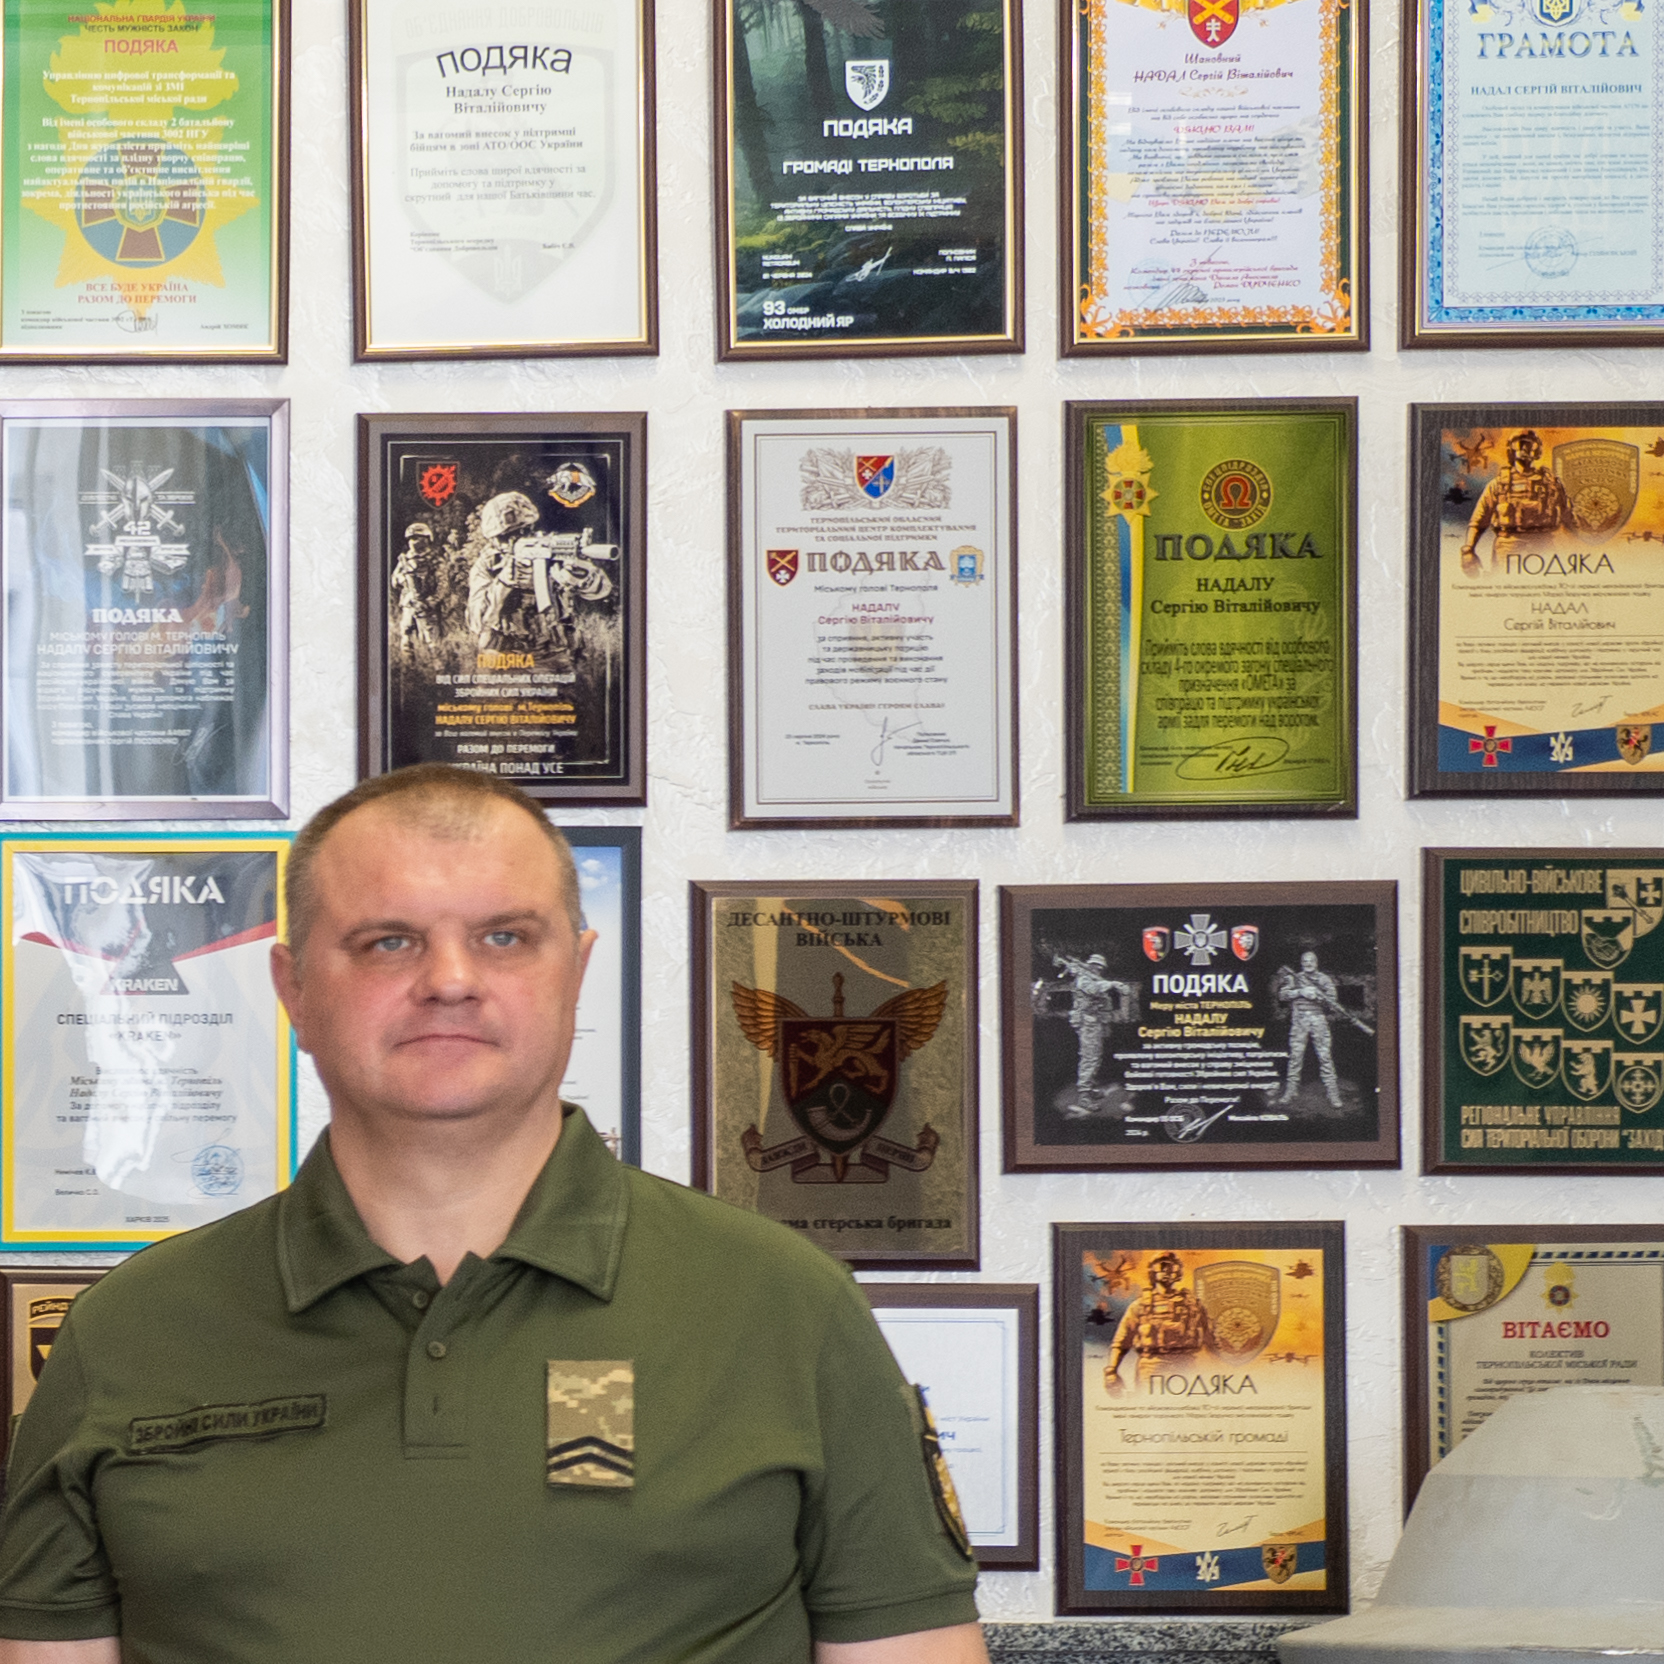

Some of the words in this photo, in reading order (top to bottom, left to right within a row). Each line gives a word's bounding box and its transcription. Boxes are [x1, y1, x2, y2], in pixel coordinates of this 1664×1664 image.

[85, 23, 112, 33] ЧЕСТЬ
[166, 24, 199, 33] ЗАКОН
[104, 38, 178, 57] ПОДЯКА
[1476, 31, 1640, 59] ГРАМОТА
[446, 86, 496, 101] Надалу
[502, 84, 551, 100] Сергію
[454, 102, 547, 117] Віталійовичу
[824, 118, 913, 139] ПОДЯКА
[783, 160, 854, 174] ГРОМАДІ
[859, 157, 953, 173] ТЕРНОПОЛЯ
[86, 283, 104, 292] ВСЕ
[109, 282, 138, 292] БУДЕ
[141, 281, 188, 292] УКРАЇНА
[763, 302, 786, 315] 93
[763, 316, 833, 330] ХОЛОДНИЙ
[837, 316, 854, 328] ЯР
[123, 521, 150, 535] 42
[1154, 532, 1322, 562] ПОДЯКА
[806, 550, 946, 576] ПОДЯКА
[1506, 553, 1614, 576] ПОДЯКА
[1197, 577, 1275, 594] НАДАЛУ
[1150, 599, 1207, 617] Сергію
[1213, 597, 1320, 617] Віталійовичу
[93, 608, 182, 626] ПОДЯКА
[63, 874, 224, 906] ПОДЯКА
[727, 910, 950, 927] ДЕСАНТНО-ШТУРМОВІ
[796, 929, 883, 947] ВІЙСЬКА
[110, 978, 178, 992] KRAKEN
[1153, 974, 1248, 996] ПОДЯКА
[1175, 1011, 1228, 1026] НАДАЛУ
[888, 1216, 951, 1231] бригада
[1502, 1321, 1610, 1341] ВІТАЄМО
[1149, 1374, 1257, 1399] ПОДЯКА
